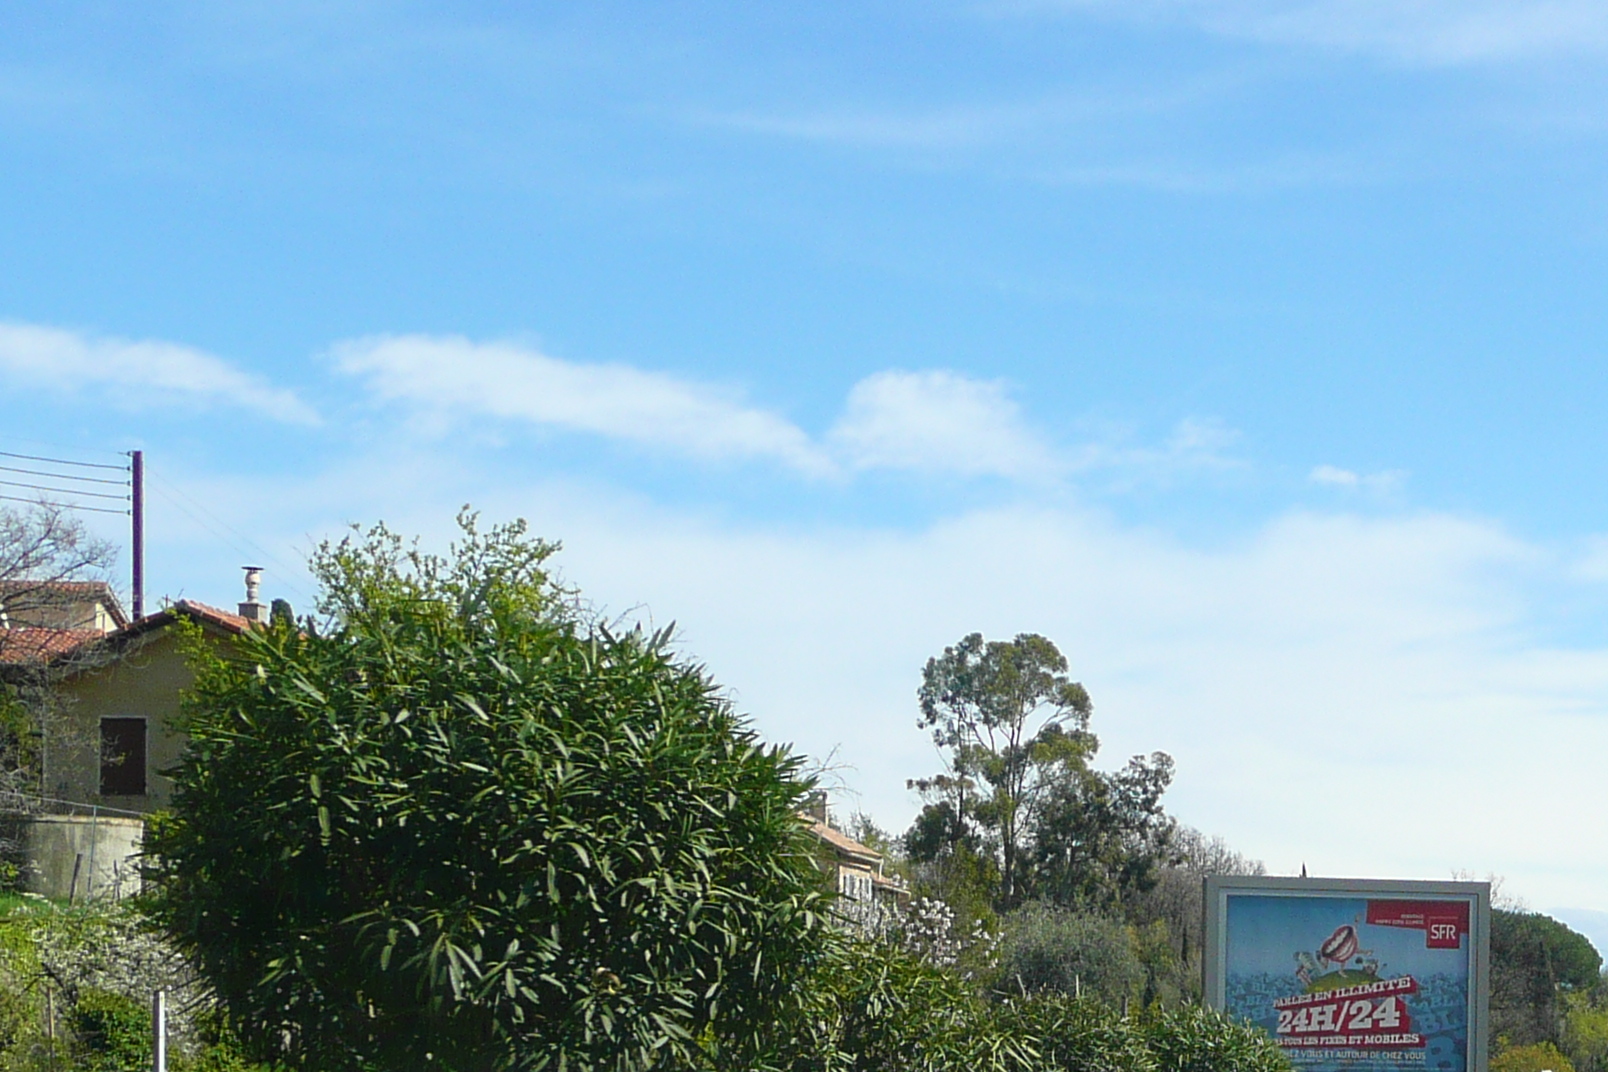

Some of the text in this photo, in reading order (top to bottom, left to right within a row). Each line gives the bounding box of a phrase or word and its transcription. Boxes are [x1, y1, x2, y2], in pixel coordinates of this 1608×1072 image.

[1430, 924, 1456, 940] SFR
[1314, 989, 1332, 1000] EN
[1276, 996, 1400, 1033] 24H/24
[1303, 1036, 1318, 1045] LES
[1320, 1035, 1347, 1045] FIXES
[1349, 1035, 1364, 1044] ET
[1364, 1033, 1420, 1044] MOBILES
[1381, 1051, 1402, 1060] CHEZ
[1404, 1051, 1426, 1061] VOUS
